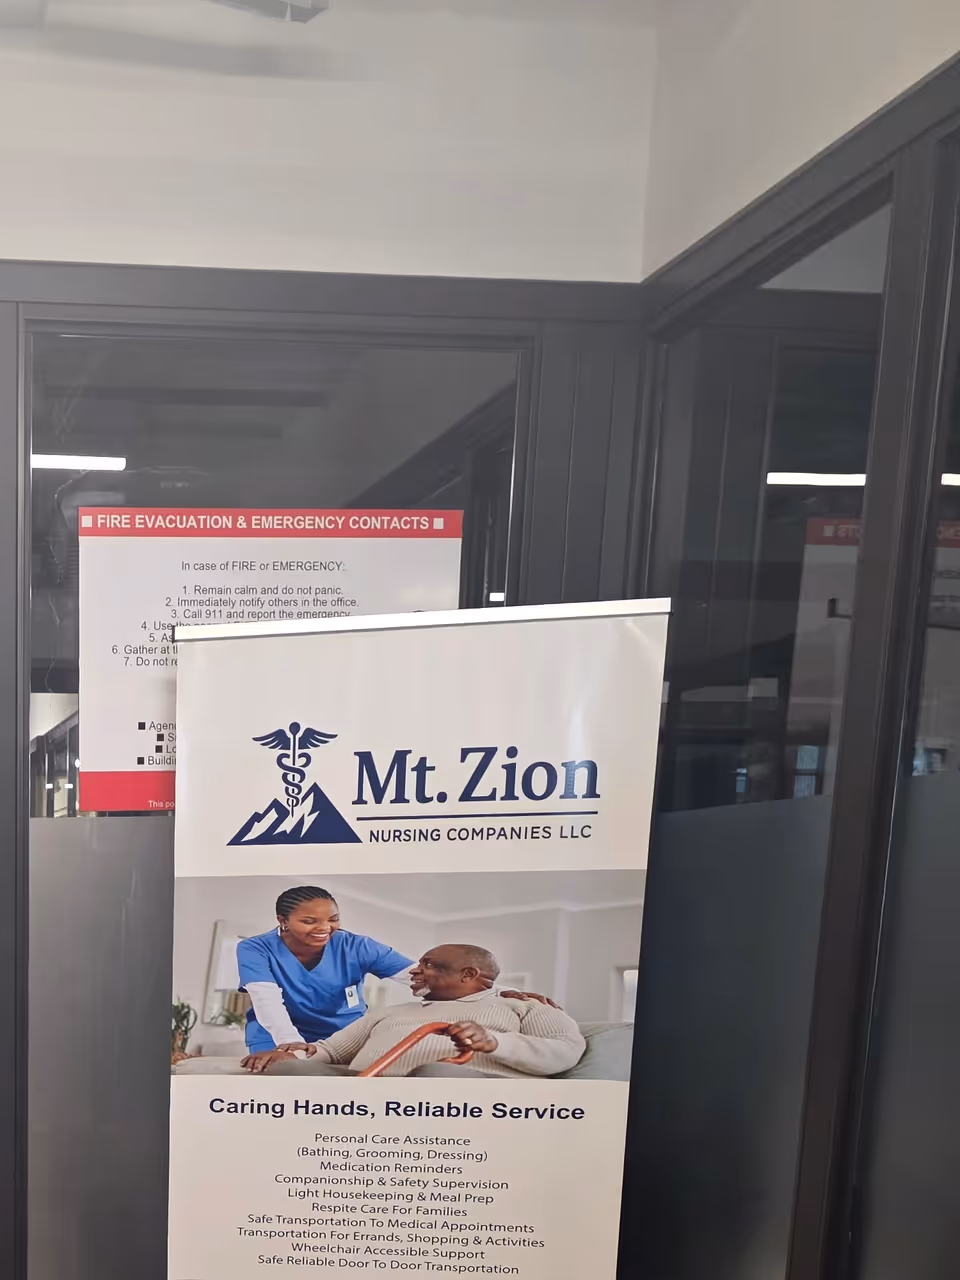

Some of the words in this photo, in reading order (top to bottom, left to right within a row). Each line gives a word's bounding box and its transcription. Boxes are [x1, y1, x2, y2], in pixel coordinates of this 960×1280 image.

[97, 514, 130, 527] FIRE
[134, 514, 233, 528] EVACUATION
[251, 515, 346, 529] EMERGENCY
[348, 516, 430, 529] CONTACTS
[182, 561, 190, 570] In
[193, 563, 216, 571] case
[219, 560, 229, 571] of
[232, 561, 256, 570] FIRE
[259, 562, 269, 571] or
[273, 560, 345, 570] EMERGENCY:
[182, 585, 190, 594] 1.
[194, 585, 231, 594] Remain
[234, 585, 257, 594] calm
[260, 585, 278, 594] and
[281, 585, 293, 594] do
[296, 586, 312, 594] not
[314, 585, 343, 596] panic.
[165, 597, 174, 606] 2.
[177, 597, 236, 608] Immediately
[239, 597, 266, 608] notify
[268, 597, 298, 606] others
[301, 597, 309, 606] in
[312, 597, 328, 606] the
[330, 597, 358, 606] office.
[171, 609, 179, 618] 3.
[183, 609, 202, 618] Call
[204, 609, 223, 618] 911
[226, 609, 244, 618] and
[247, 610, 276, 620] report
[279, 610, 294, 618] the
[140, 621, 149, 630] 4.
[153, 621, 173, 630] Use
[149, 632, 157, 642] 5.
[112, 645, 120, 654] 6.
[124, 645, 157, 654] Gather
[160, 646, 169, 654] at
[124, 656, 132, 665] 7.
[136, 656, 149, 666] Do
[152, 657, 168, 666] not
[352, 749, 448, 805] Mt.
[458, 746, 601, 802] Zion
[369, 828, 441, 843] NURSING
[446, 826, 552, 841] COMPANIES
[559, 825, 592, 839] LLC
[208, 1097, 285, 1118] Caring
[293, 1099, 375, 1119] Hands,
[384, 1100, 483, 1118] Reliable
[491, 1102, 585, 1120] Service
[314, 1134, 368, 1144] Personal
[371, 1134, 400, 1144] Care
[403, 1135, 471, 1145] Assistance
[296, 1147, 352, 1158] (Bathing,
[356, 1148, 423, 1160] Grooming,
[427, 1150, 487, 1162] Dressing)
[321, 1161, 390, 1171] Medication
[393, 1163, 463, 1174] Reminders
[274, 1175, 373, 1187] Companionship
[388, 1178, 429, 1188] Safety
[432, 1179, 508, 1189] Supervision
[287, 1189, 319, 1199] Light
[323, 1190, 413, 1202] Housekeeping
[431, 1193, 461, 1202] Meal
[464, 1194, 494, 1204] Prep
[311, 1202, 357, 1214] Respite
[360, 1204, 389, 1213] Care
[392, 1205, 411, 1214] For
[415, 1206, 468, 1216] Families
[246, 1214, 273, 1222] Safe
[276, 1215, 367, 1226] Transportation
[371, 1218, 384, 1226] To
[389, 1219, 437, 1229] Medical
[440, 1221, 535, 1232] Appointments
[238, 1227, 326, 1238] Transportation
[330, 1231, 348, 1239] For
[352, 1232, 404, 1243] Errands,
[406, 1234, 469, 1246] Shopping
[485, 1237, 546, 1247] Activities
[292, 1243, 359, 1253] Wheelchair
[363, 1246, 430, 1256] Accessible
[432, 1248, 483, 1260] Support
[257, 1255, 284, 1263] Safe
[286, 1256, 335, 1266] Reliable
[339, 1258, 368, 1267] Door
[374, 1260, 387, 1268] To
[391, 1260, 420, 1269] Door
[425, 1262, 519, 1273] Transportation
